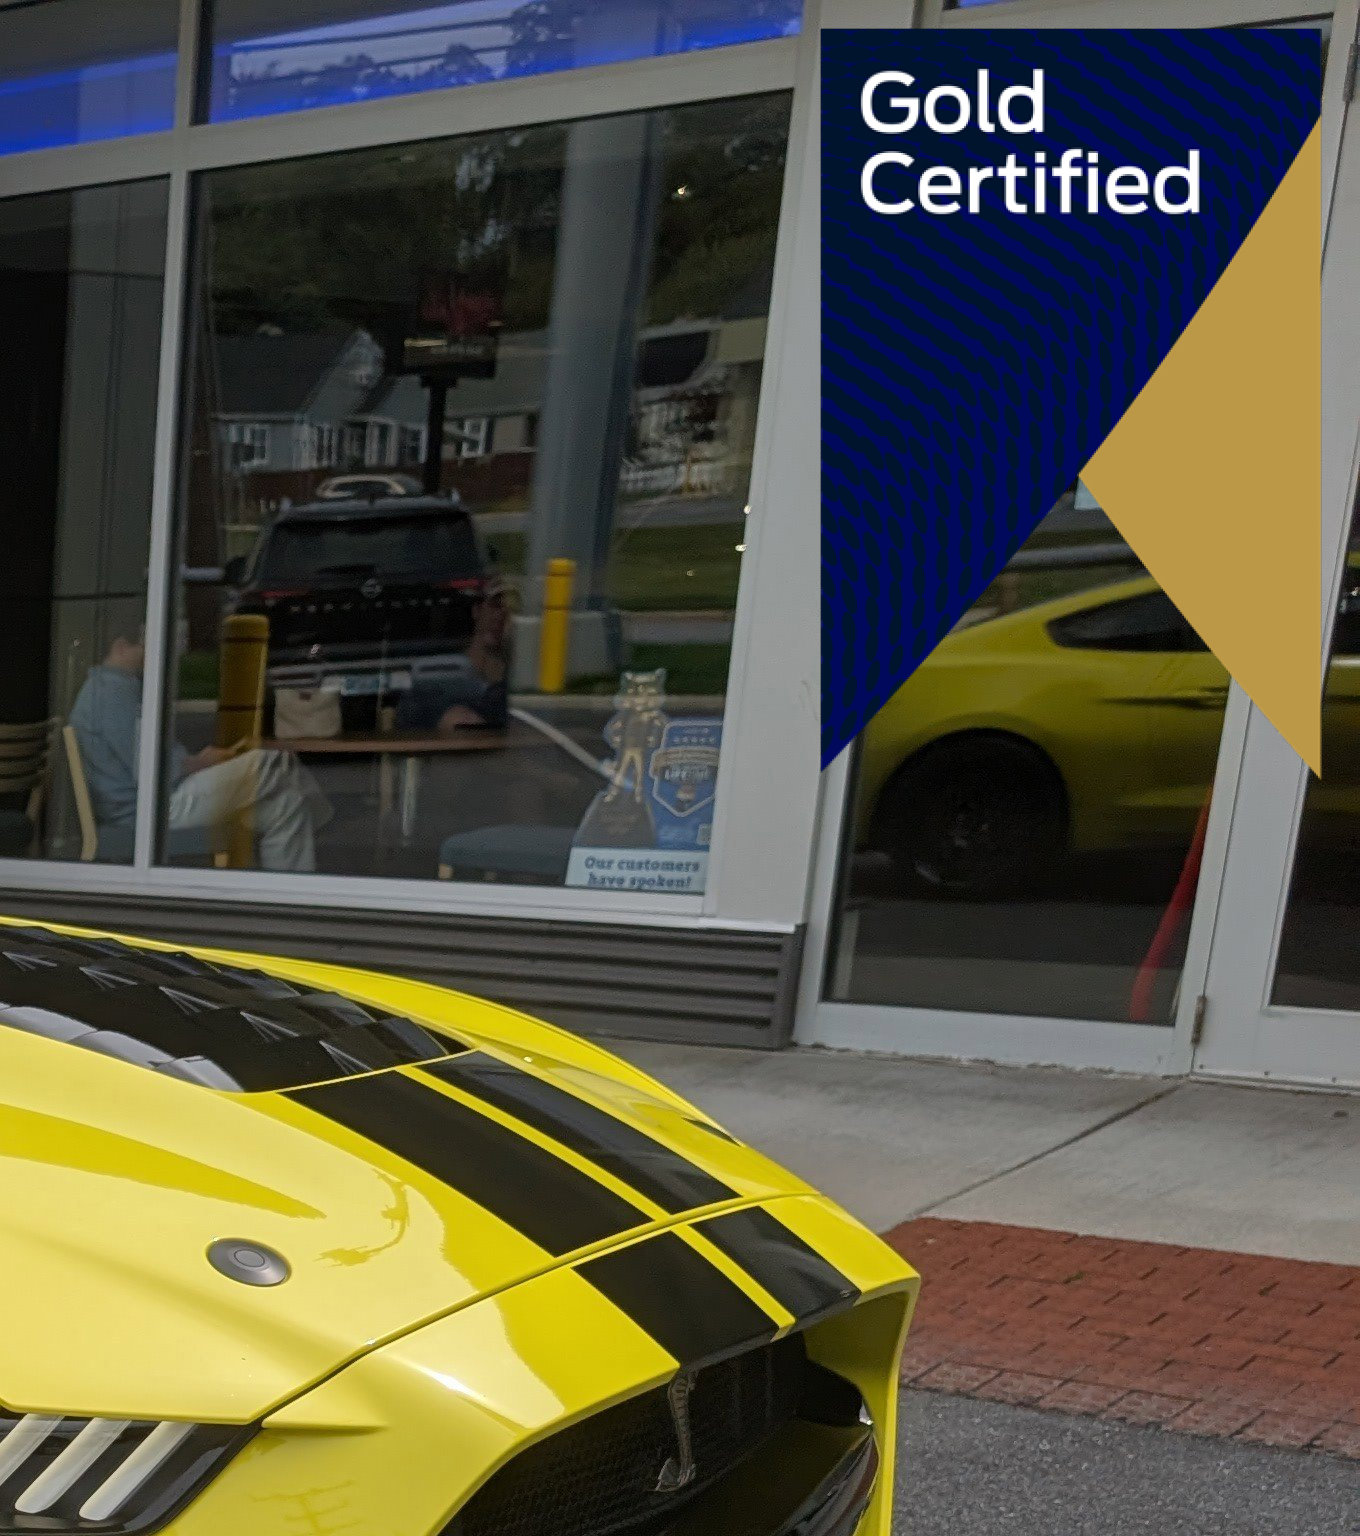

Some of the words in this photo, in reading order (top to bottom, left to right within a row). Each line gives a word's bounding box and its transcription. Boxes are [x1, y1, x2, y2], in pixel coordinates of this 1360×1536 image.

[584, 855, 615, 870] Our
[617, 858, 700, 873] customers
[587, 871, 626, 886] have
[629, 873, 692, 889] spoken!
